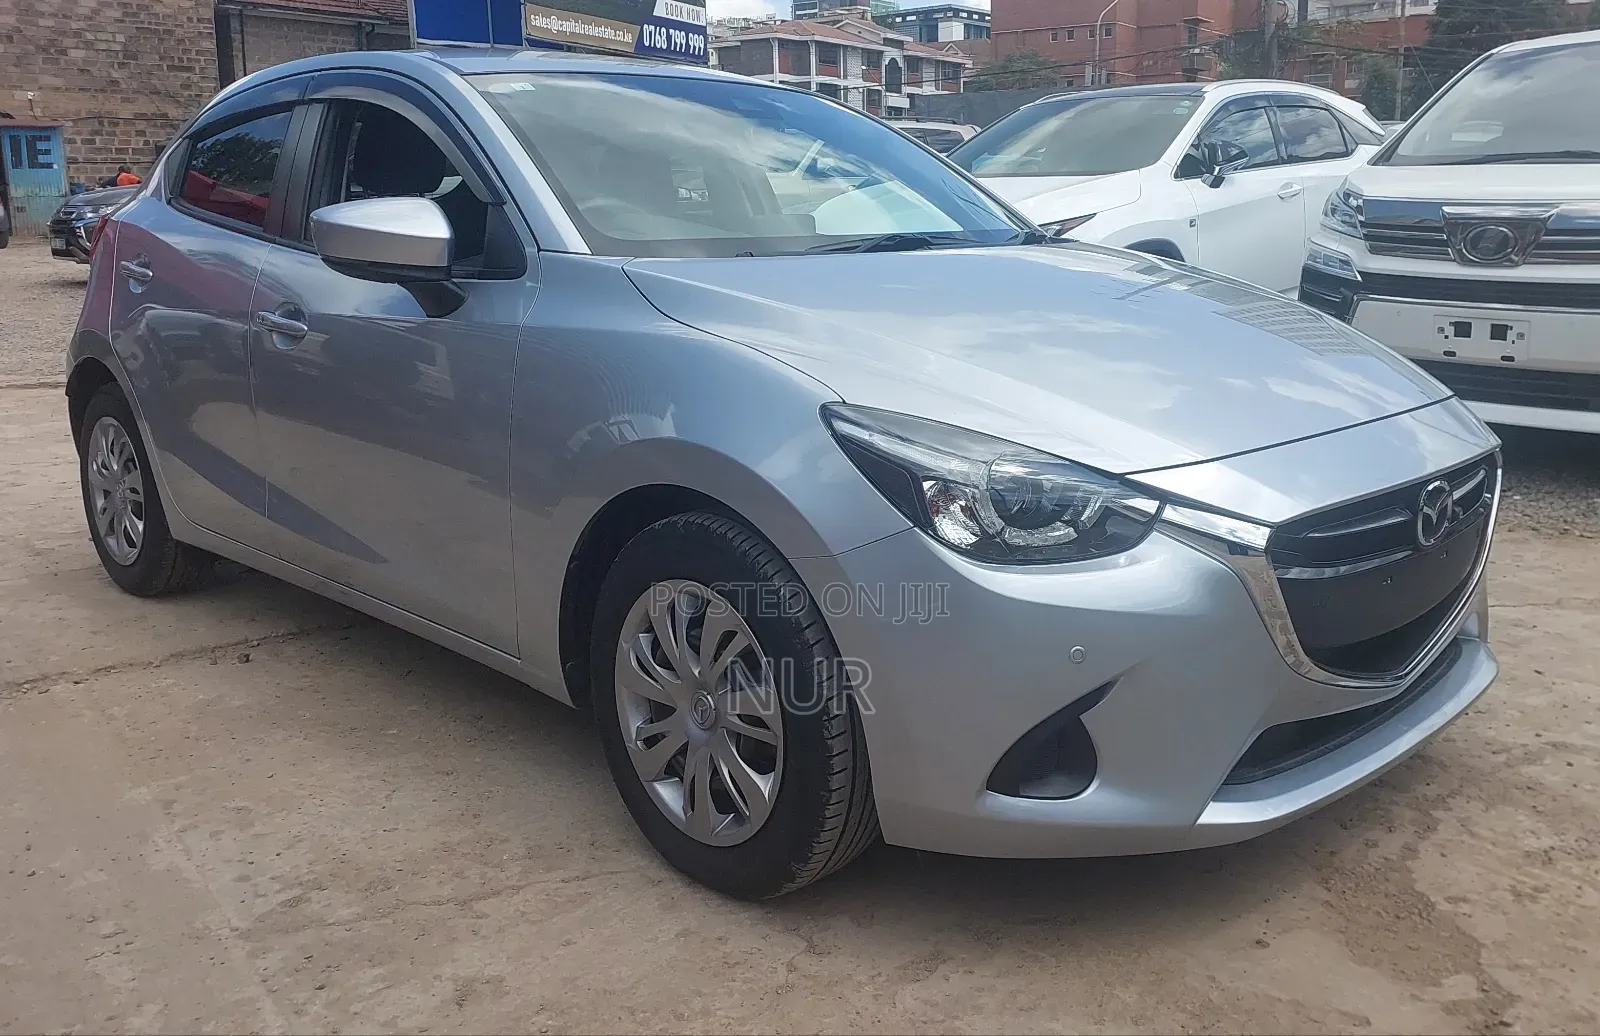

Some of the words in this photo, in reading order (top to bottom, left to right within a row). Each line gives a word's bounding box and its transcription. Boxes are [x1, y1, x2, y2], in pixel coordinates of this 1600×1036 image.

[664, 2, 684, 19] BOOK
[530, 13, 633, 43] sales@capitalrealestate.co.ke
[643, 24, 667, 50] 0768
[669, 29, 686, 53] 799
[688, 32, 704, 56] 999
